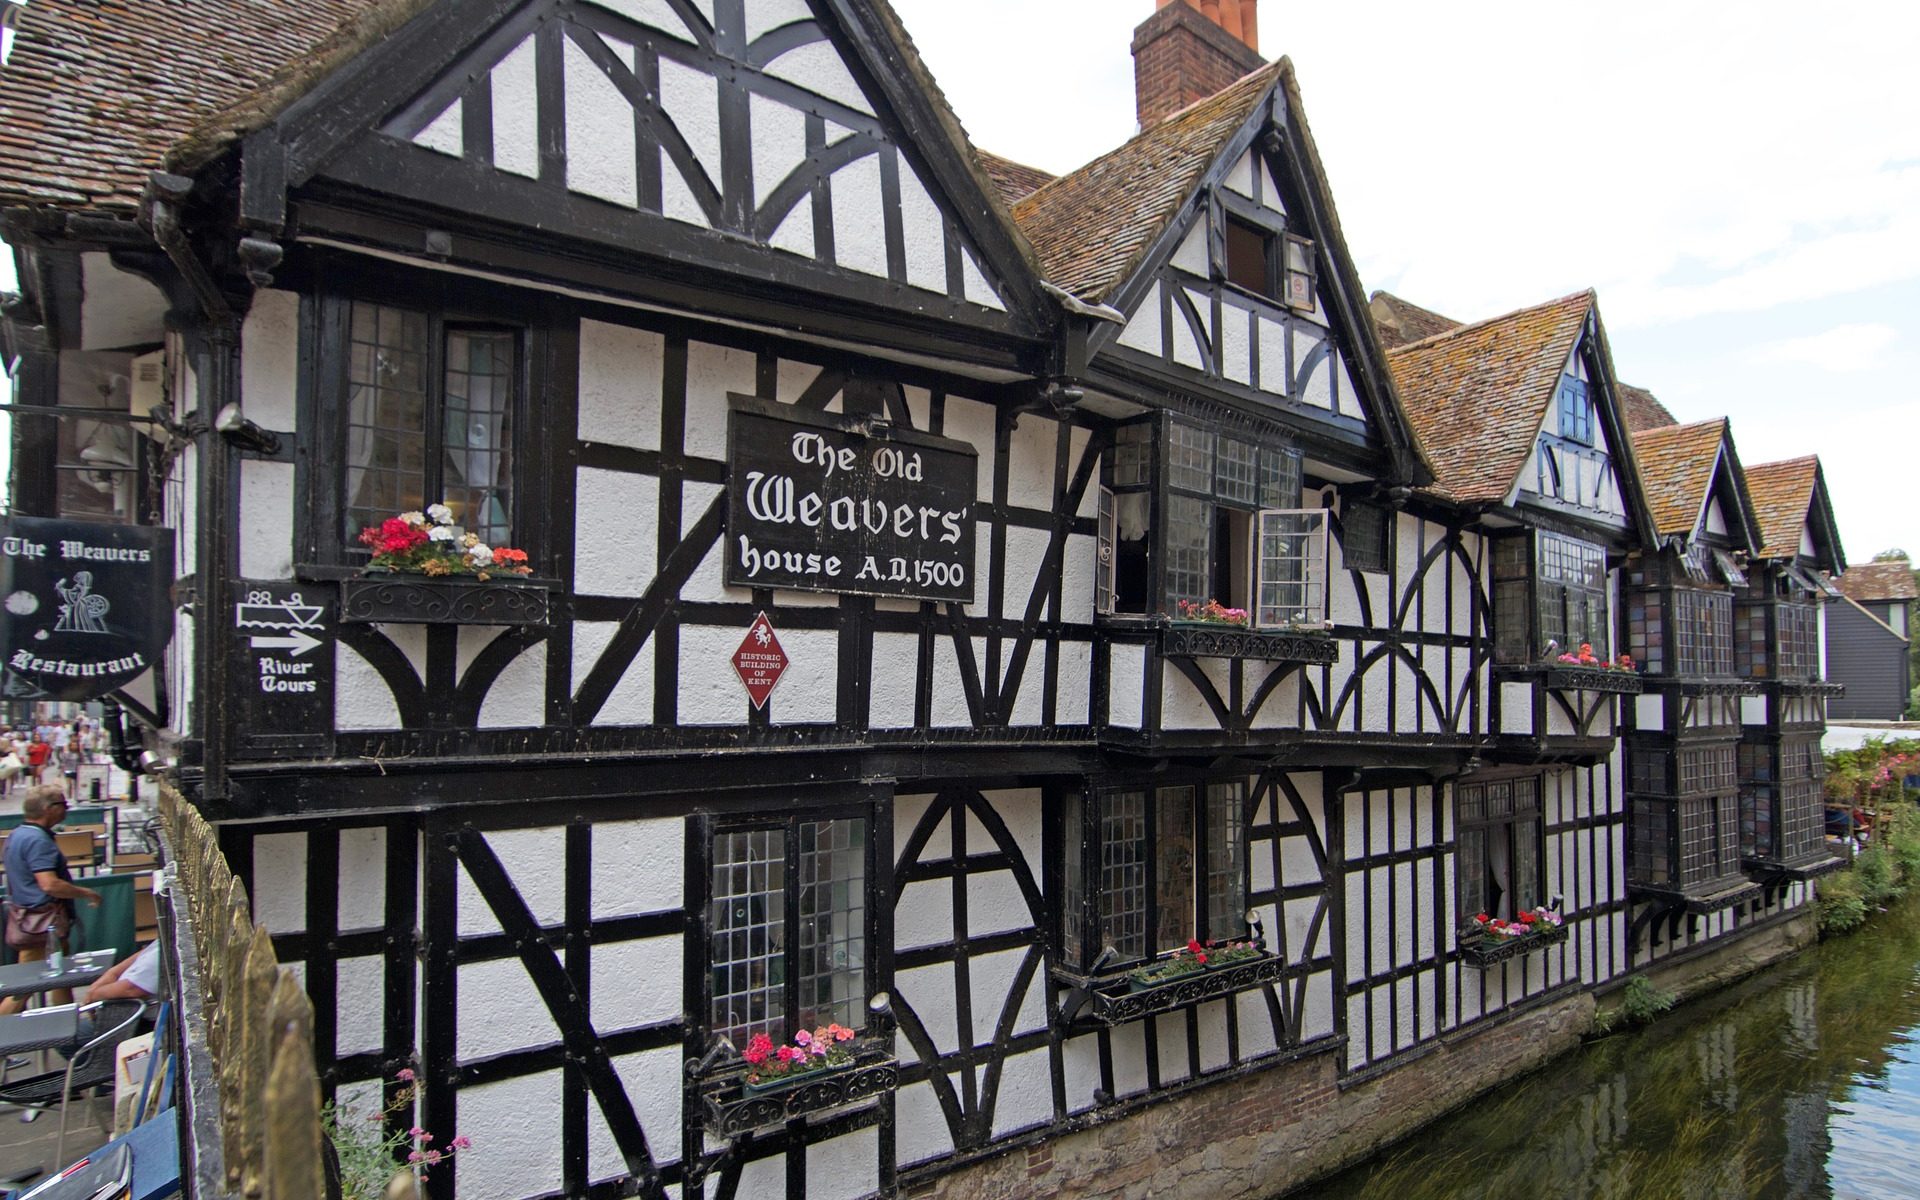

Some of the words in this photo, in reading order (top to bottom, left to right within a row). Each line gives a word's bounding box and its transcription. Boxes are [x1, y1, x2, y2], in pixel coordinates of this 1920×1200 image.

[793, 432, 857, 477] The
[873, 447, 923, 482] Old
[746, 471, 967, 544] Weavers'
[3, 536, 47, 560] The
[59, 540, 151, 562] Weavers
[9, 648, 146, 676] Restaurant
[259, 657, 313, 675] River
[740, 652, 781, 661] HISTORIC
[740, 661, 781, 669] BUILDING
[260, 675, 316, 692] Tours
